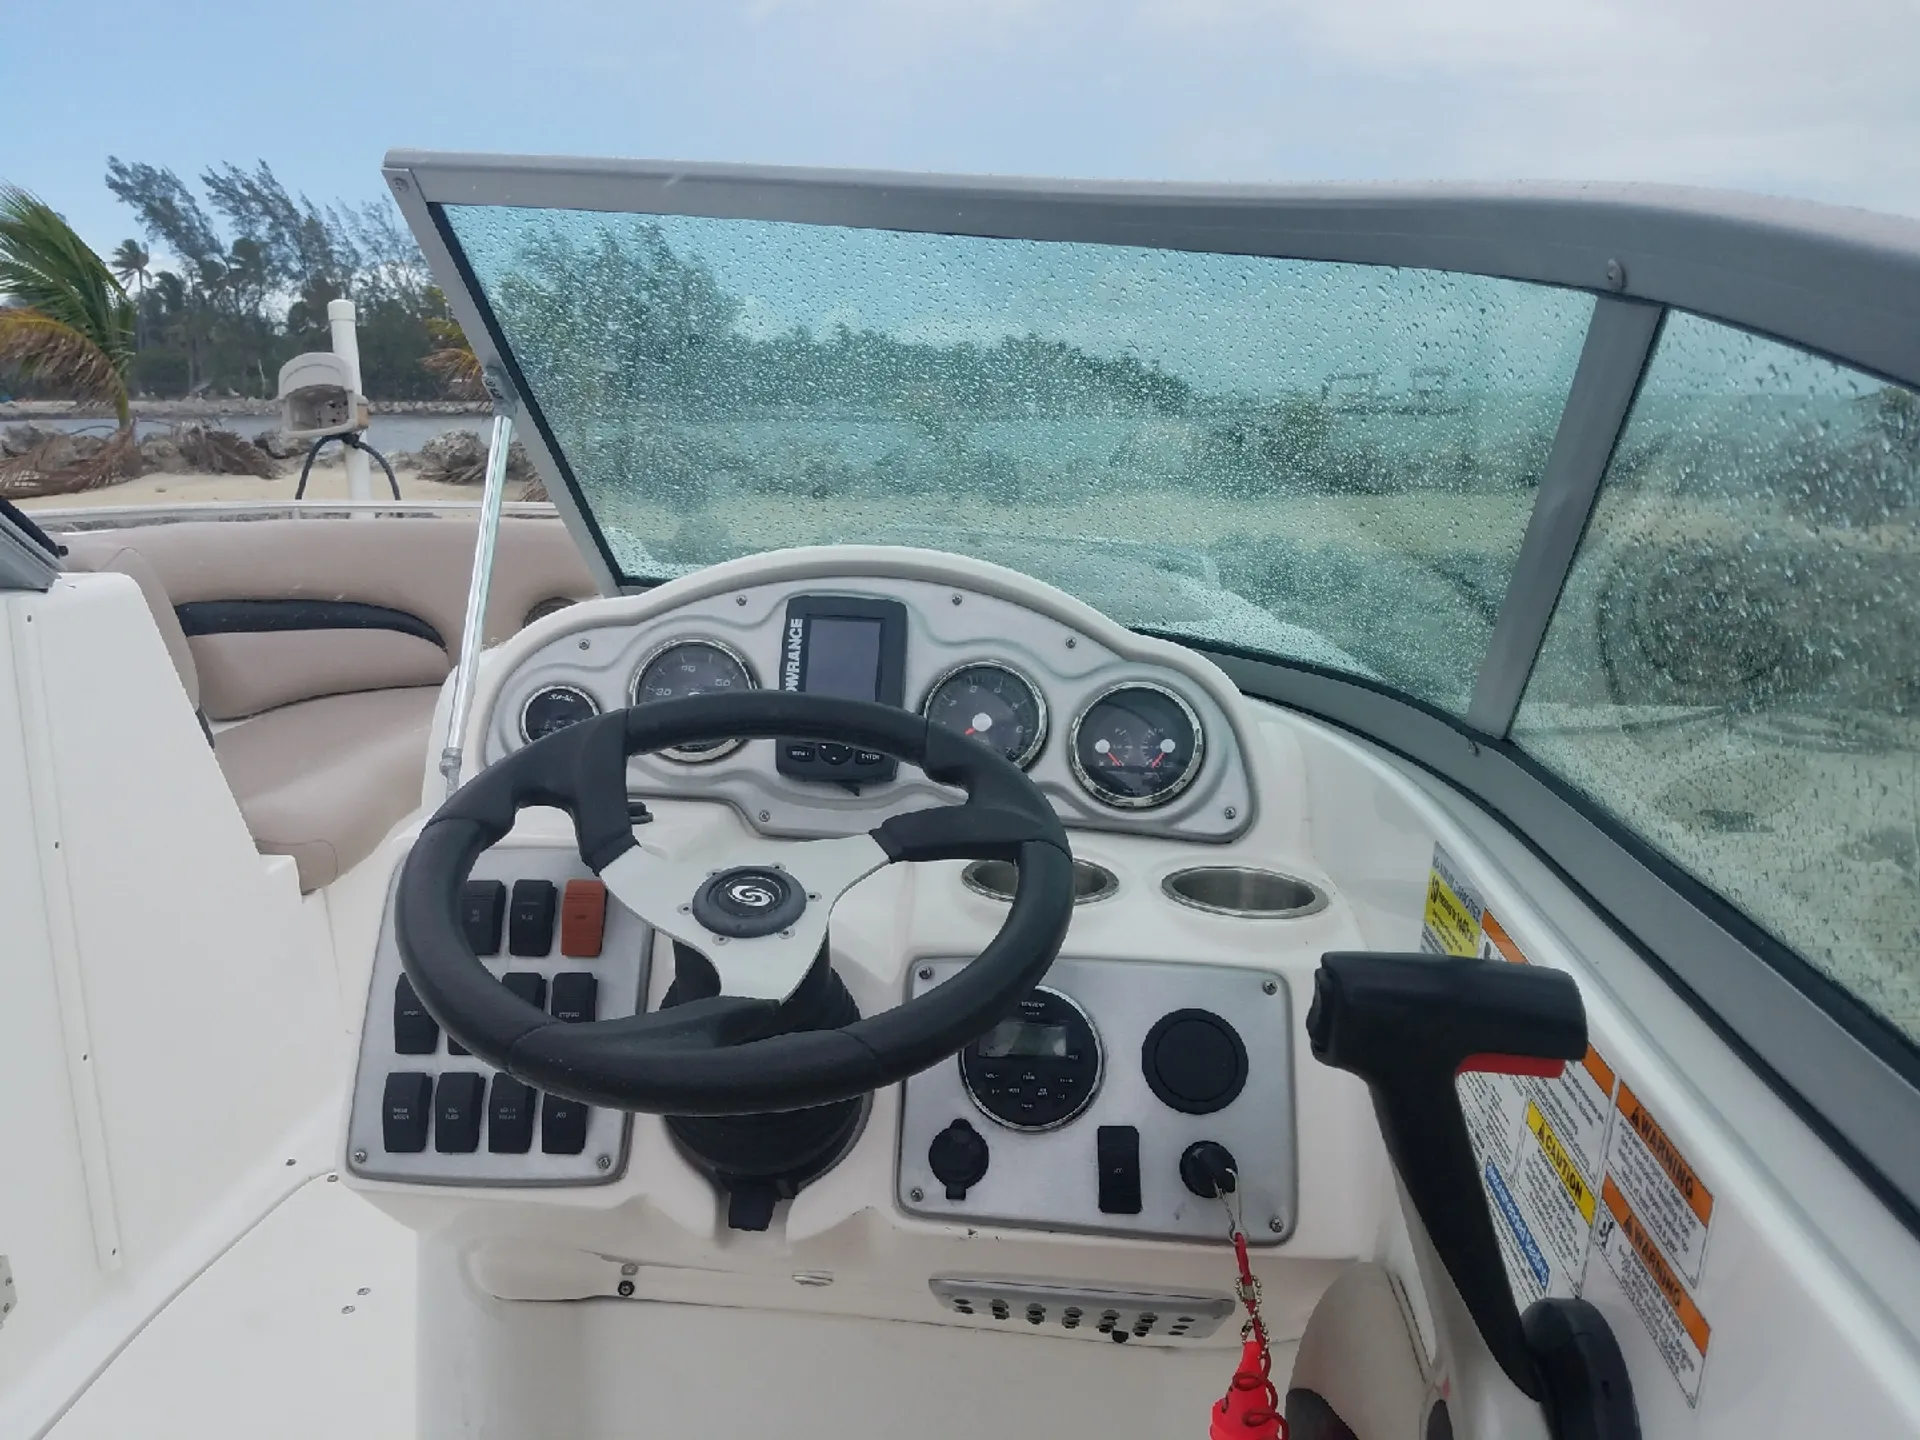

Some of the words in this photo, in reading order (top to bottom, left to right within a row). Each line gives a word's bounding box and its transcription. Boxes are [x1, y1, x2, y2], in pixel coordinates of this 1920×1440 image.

[655, 687, 672, 697] 30
[785, 618, 803, 692] WRANCE
[1545, 1135, 1583, 1201] CAUTION
[1641, 1115, 1693, 1201] WARNING
[1634, 1226, 1681, 1308] WARNING
